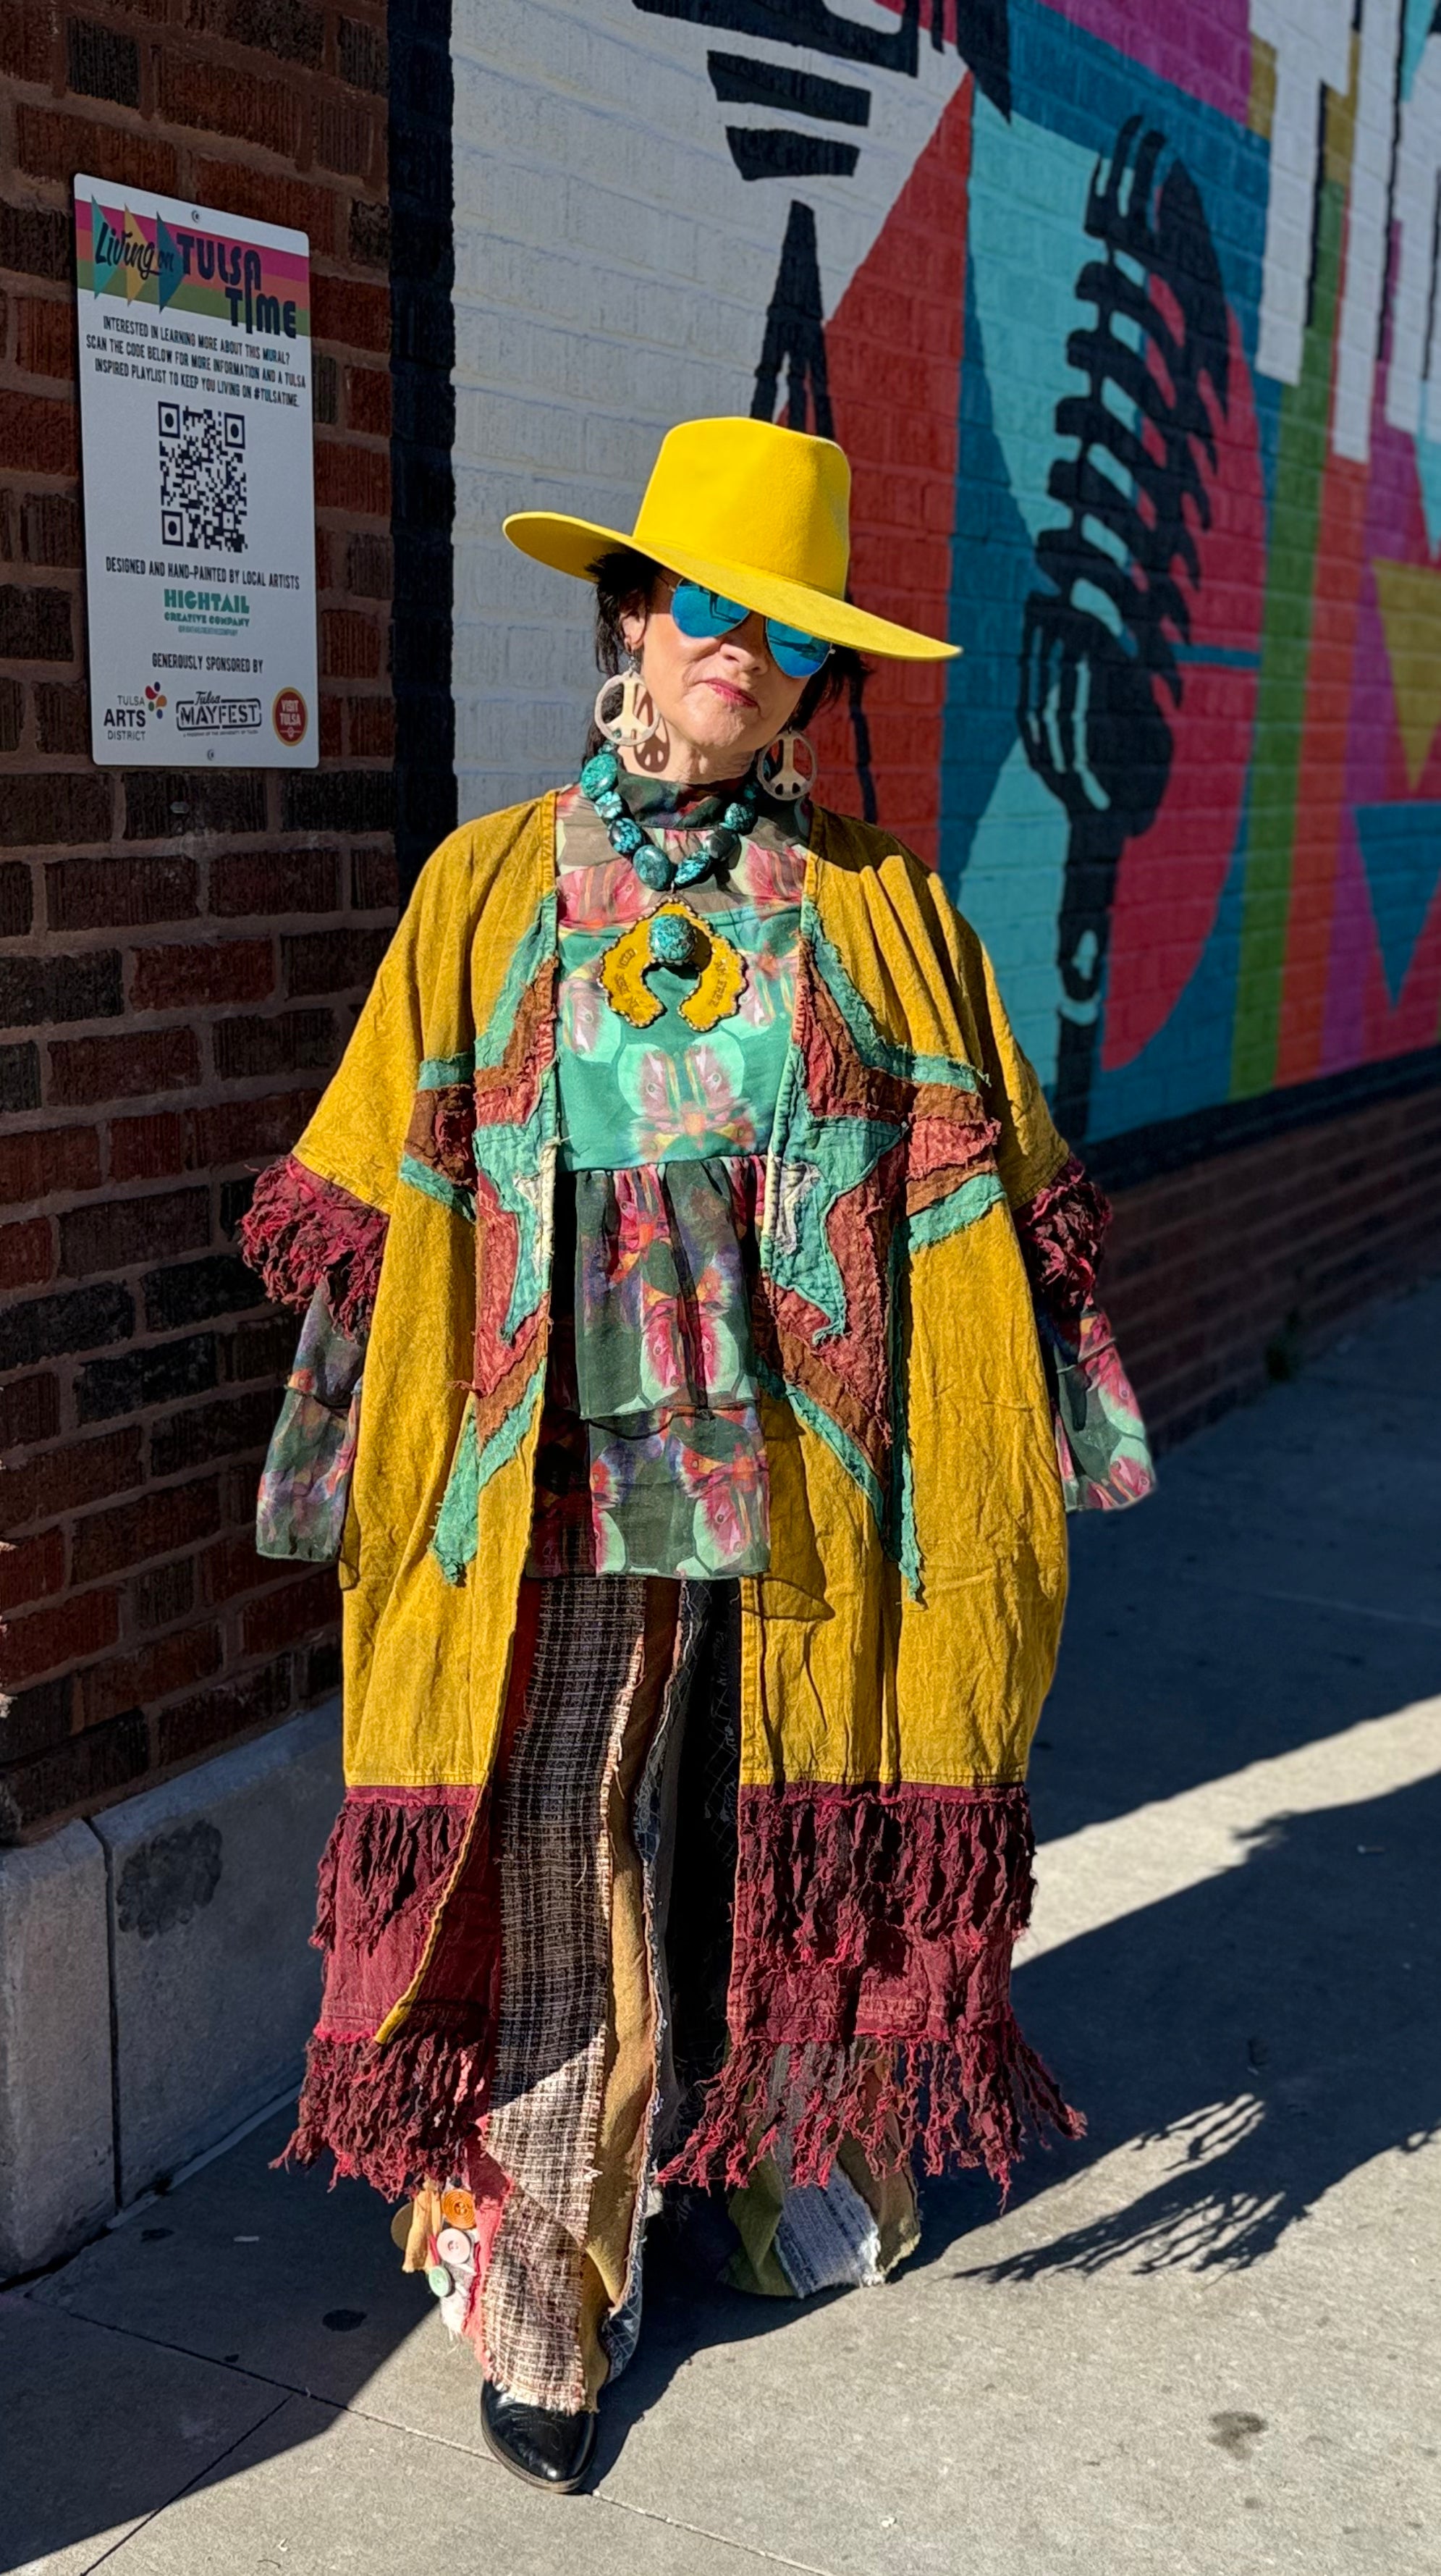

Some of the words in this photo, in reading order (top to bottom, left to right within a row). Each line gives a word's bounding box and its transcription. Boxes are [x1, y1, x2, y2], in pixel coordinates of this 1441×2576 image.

[95, 222, 160, 280] Living
[176, 232, 261, 291] TULSA
[225, 287, 296, 339] TIME
[103, 315, 148, 337] INTERESTED
[151, 324, 159, 340] IN
[161, 327, 195, 347] LEARNING
[198, 334, 218, 351] MORE
[220, 339, 242, 356] ABOUT
[245, 343, 261, 360] THIS
[263, 348, 290, 365] MURAL?
[86, 334, 107, 351] SCAN
[109, 338, 124, 354] THE
[126, 342, 145, 358] CODE
[147, 345, 172, 363] BELOW
[174, 350, 189, 367] FOR
[191, 354, 211, 371] MORE
[213, 358, 260, 380] INFORMATION
[262, 367, 276, 382] AND
[278, 371, 283, 384] A
[284, 371, 306, 389] TULSA
[95, 358, 130, 377] INSPIRED
[131, 364, 167, 384] PLAYLIST
[169, 371, 179, 386] TO
[181, 374, 199, 389] KEEP
[200, 376, 216, 392] YOU
[217, 379, 240, 397] LIVING
[242, 384, 252, 399] ON
[106, 556, 145, 575] DESIGNED
[149, 560, 165, 577] AND
[167, 563, 227, 583] HAND-PAINTED
[229, 568, 240, 584] BY
[242, 571, 266, 586] LOCAL
[269, 573, 300, 590] ARTISTS
[164, 589, 250, 614] HIGHTAIL
[164, 612, 207, 624] CREATIVE
[208, 616, 250, 628] COMPANY
[152, 652, 203, 670] GENEROUSLY
[206, 656, 250, 673] SPONSORED
[253, 658, 263, 674] BY
[117, 695, 145, 707] TULSA
[195, 691, 221, 706] Tulsa
[103, 708, 146, 728] ARTS
[180, 704, 258, 725] MAYFEST
[279, 712, 301, 726] TULSA
[107, 730, 146, 741] DISTRICT
